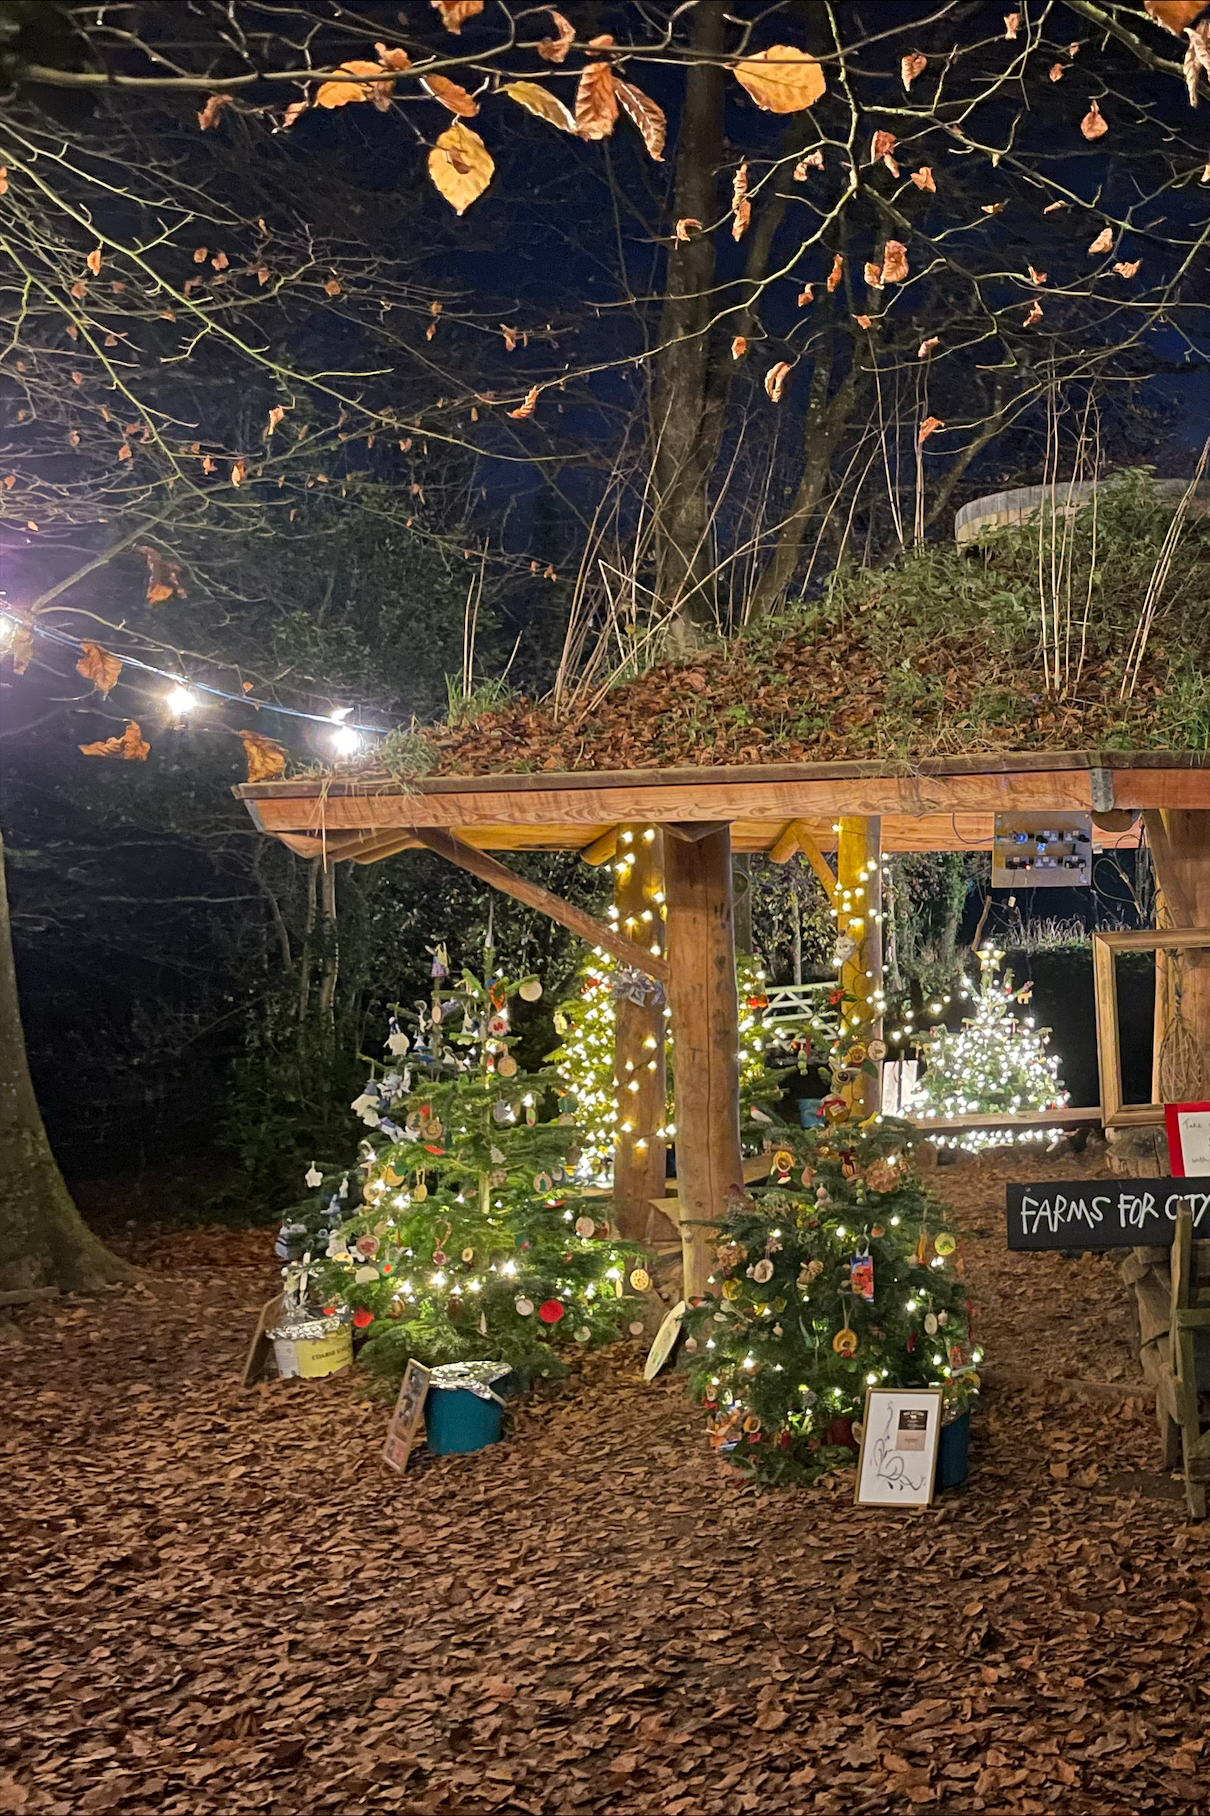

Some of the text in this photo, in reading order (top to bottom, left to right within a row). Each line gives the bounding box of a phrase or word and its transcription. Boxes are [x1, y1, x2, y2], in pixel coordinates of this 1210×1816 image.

[1183, 1117, 1203, 1130] Take
[1191, 1154, 1210, 1164] with
[1020, 1193, 1112, 1235] FARMS
[1117, 1191, 1160, 1229] FOR
